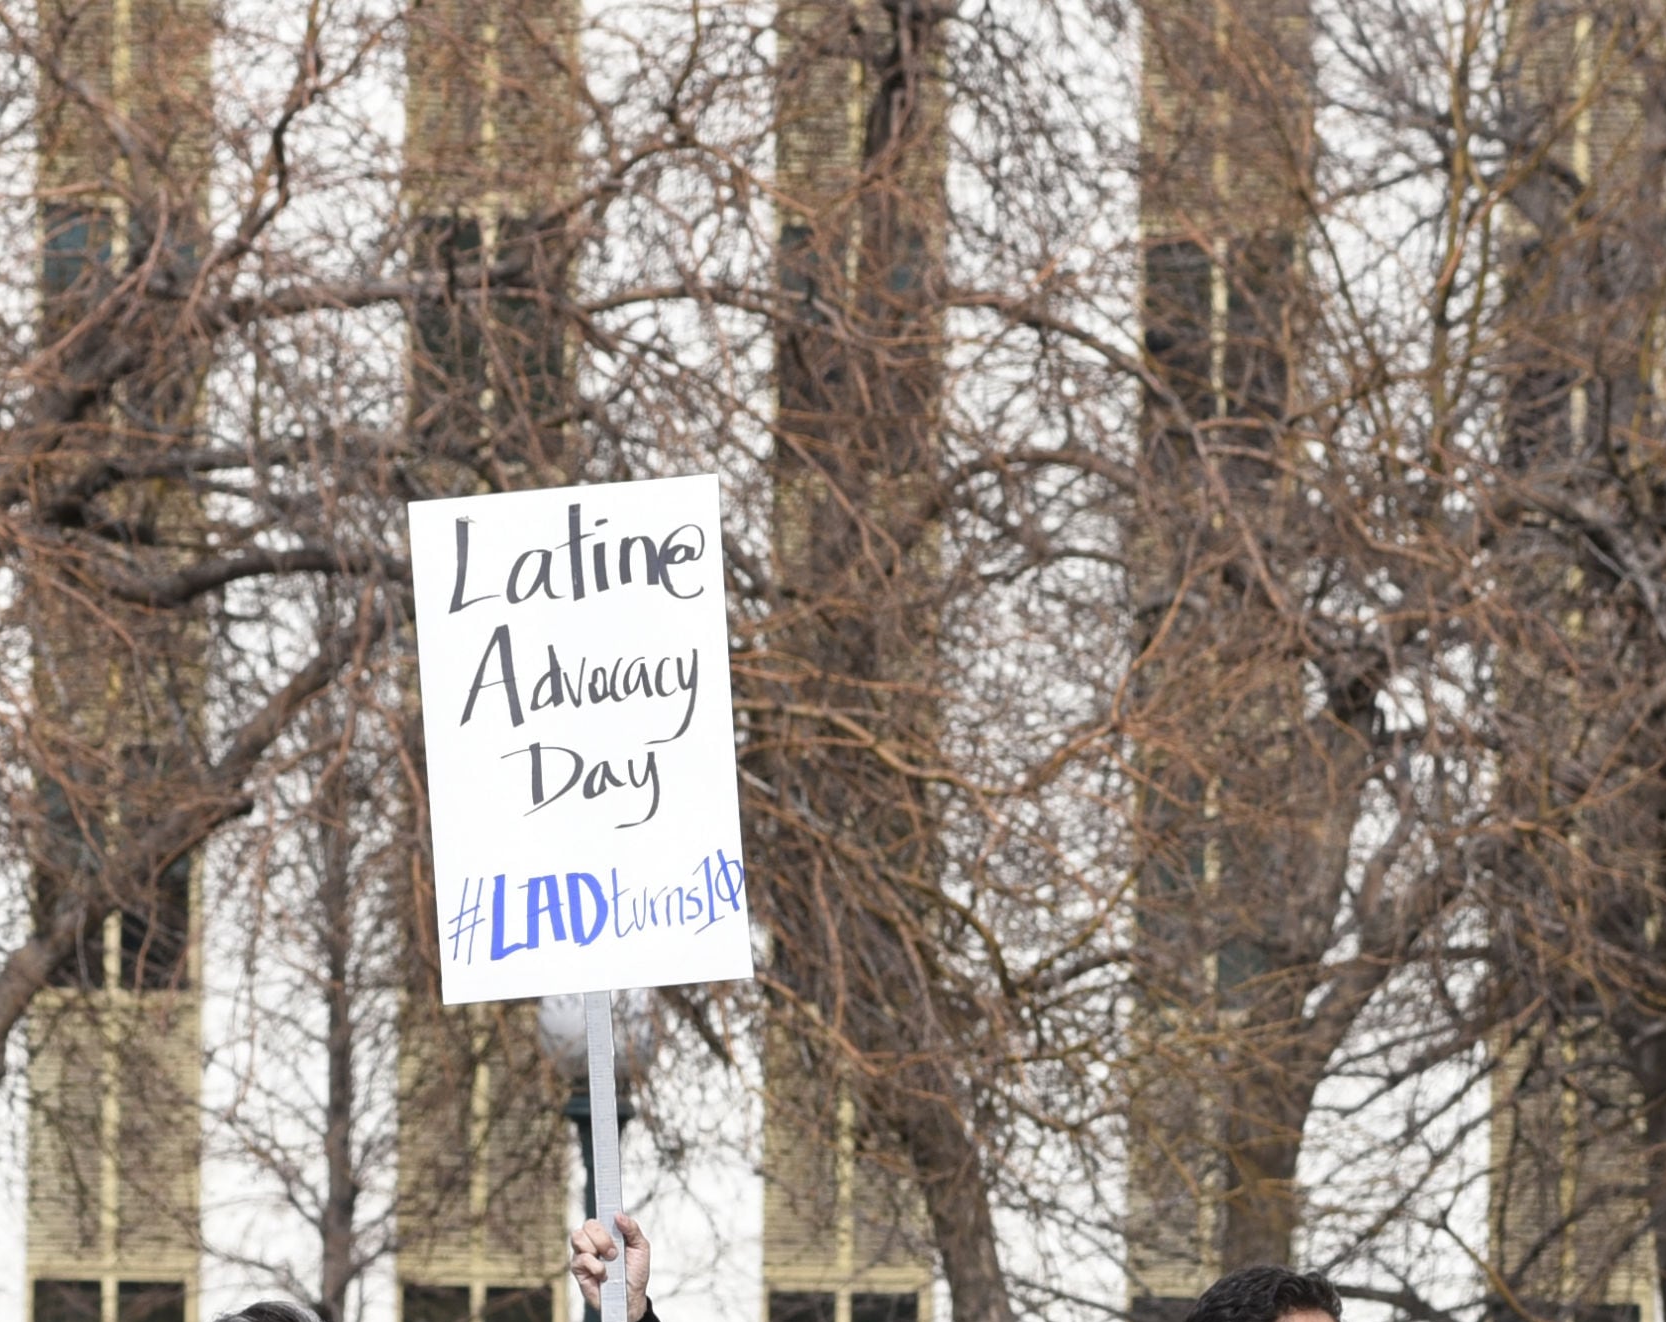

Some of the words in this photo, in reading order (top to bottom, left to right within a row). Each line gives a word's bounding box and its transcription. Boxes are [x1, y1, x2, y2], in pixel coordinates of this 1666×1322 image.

[449, 503, 705, 614] Latin@
[460, 624, 699, 745] Advocacy
[500, 742, 661, 829] Day
